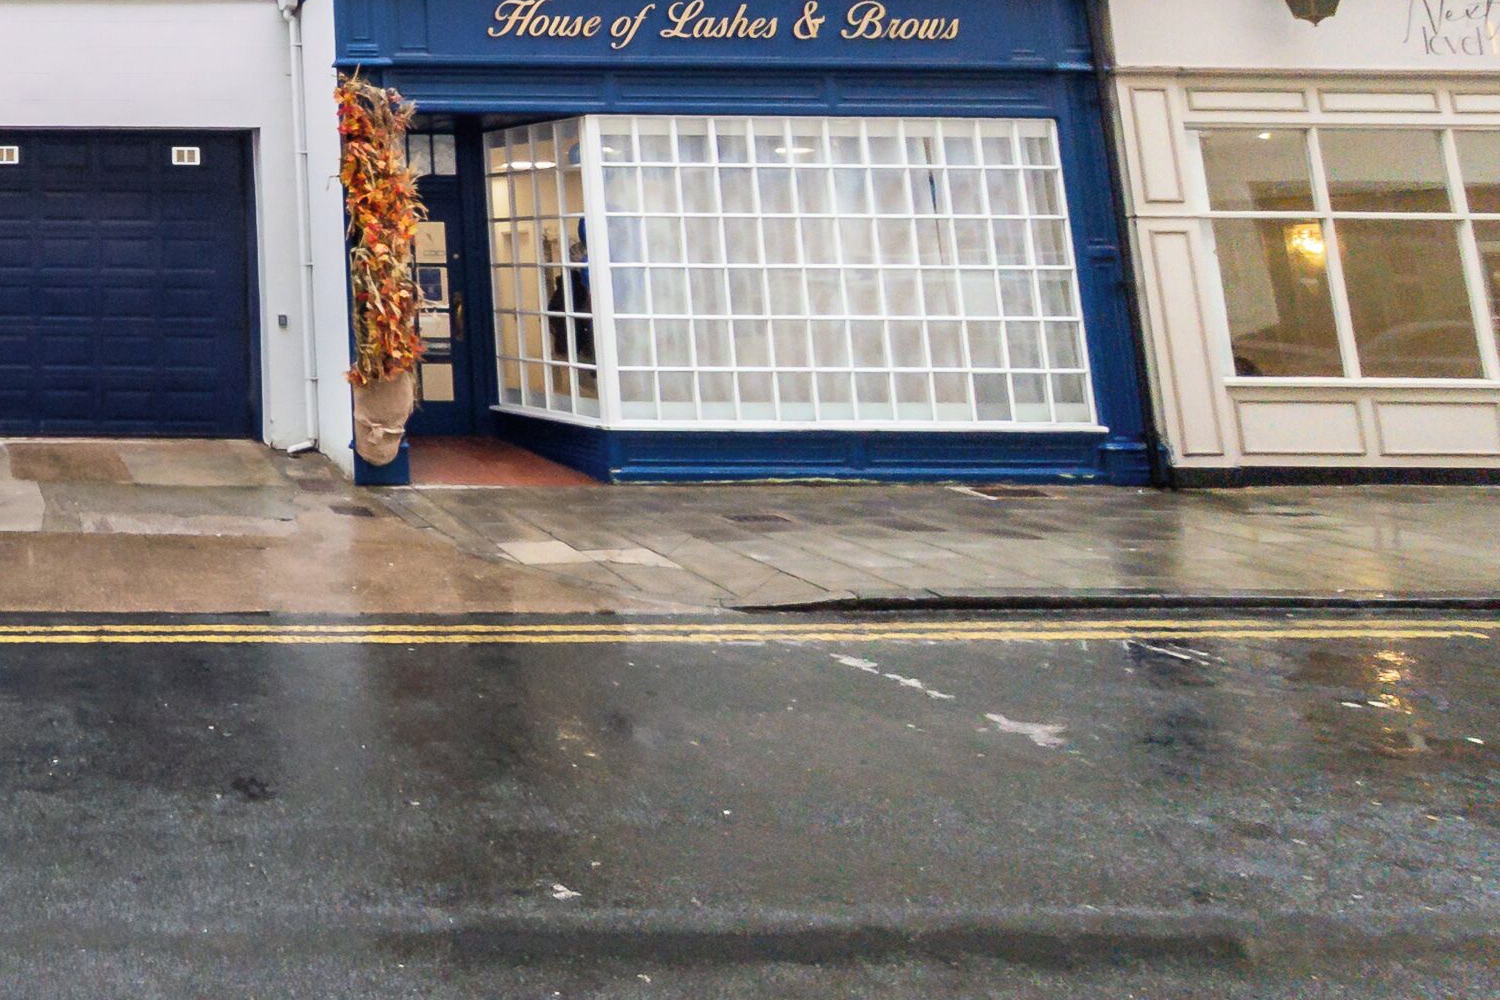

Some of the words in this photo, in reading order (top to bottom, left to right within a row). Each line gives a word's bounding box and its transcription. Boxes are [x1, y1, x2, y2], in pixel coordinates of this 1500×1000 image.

[611, 3, 656, 50] of
[660, 0, 778, 38] Lashes
[794, 0, 825, 39] &
[841, 0, 959, 39] Brows
[1422, 26, 1484, 56] level
